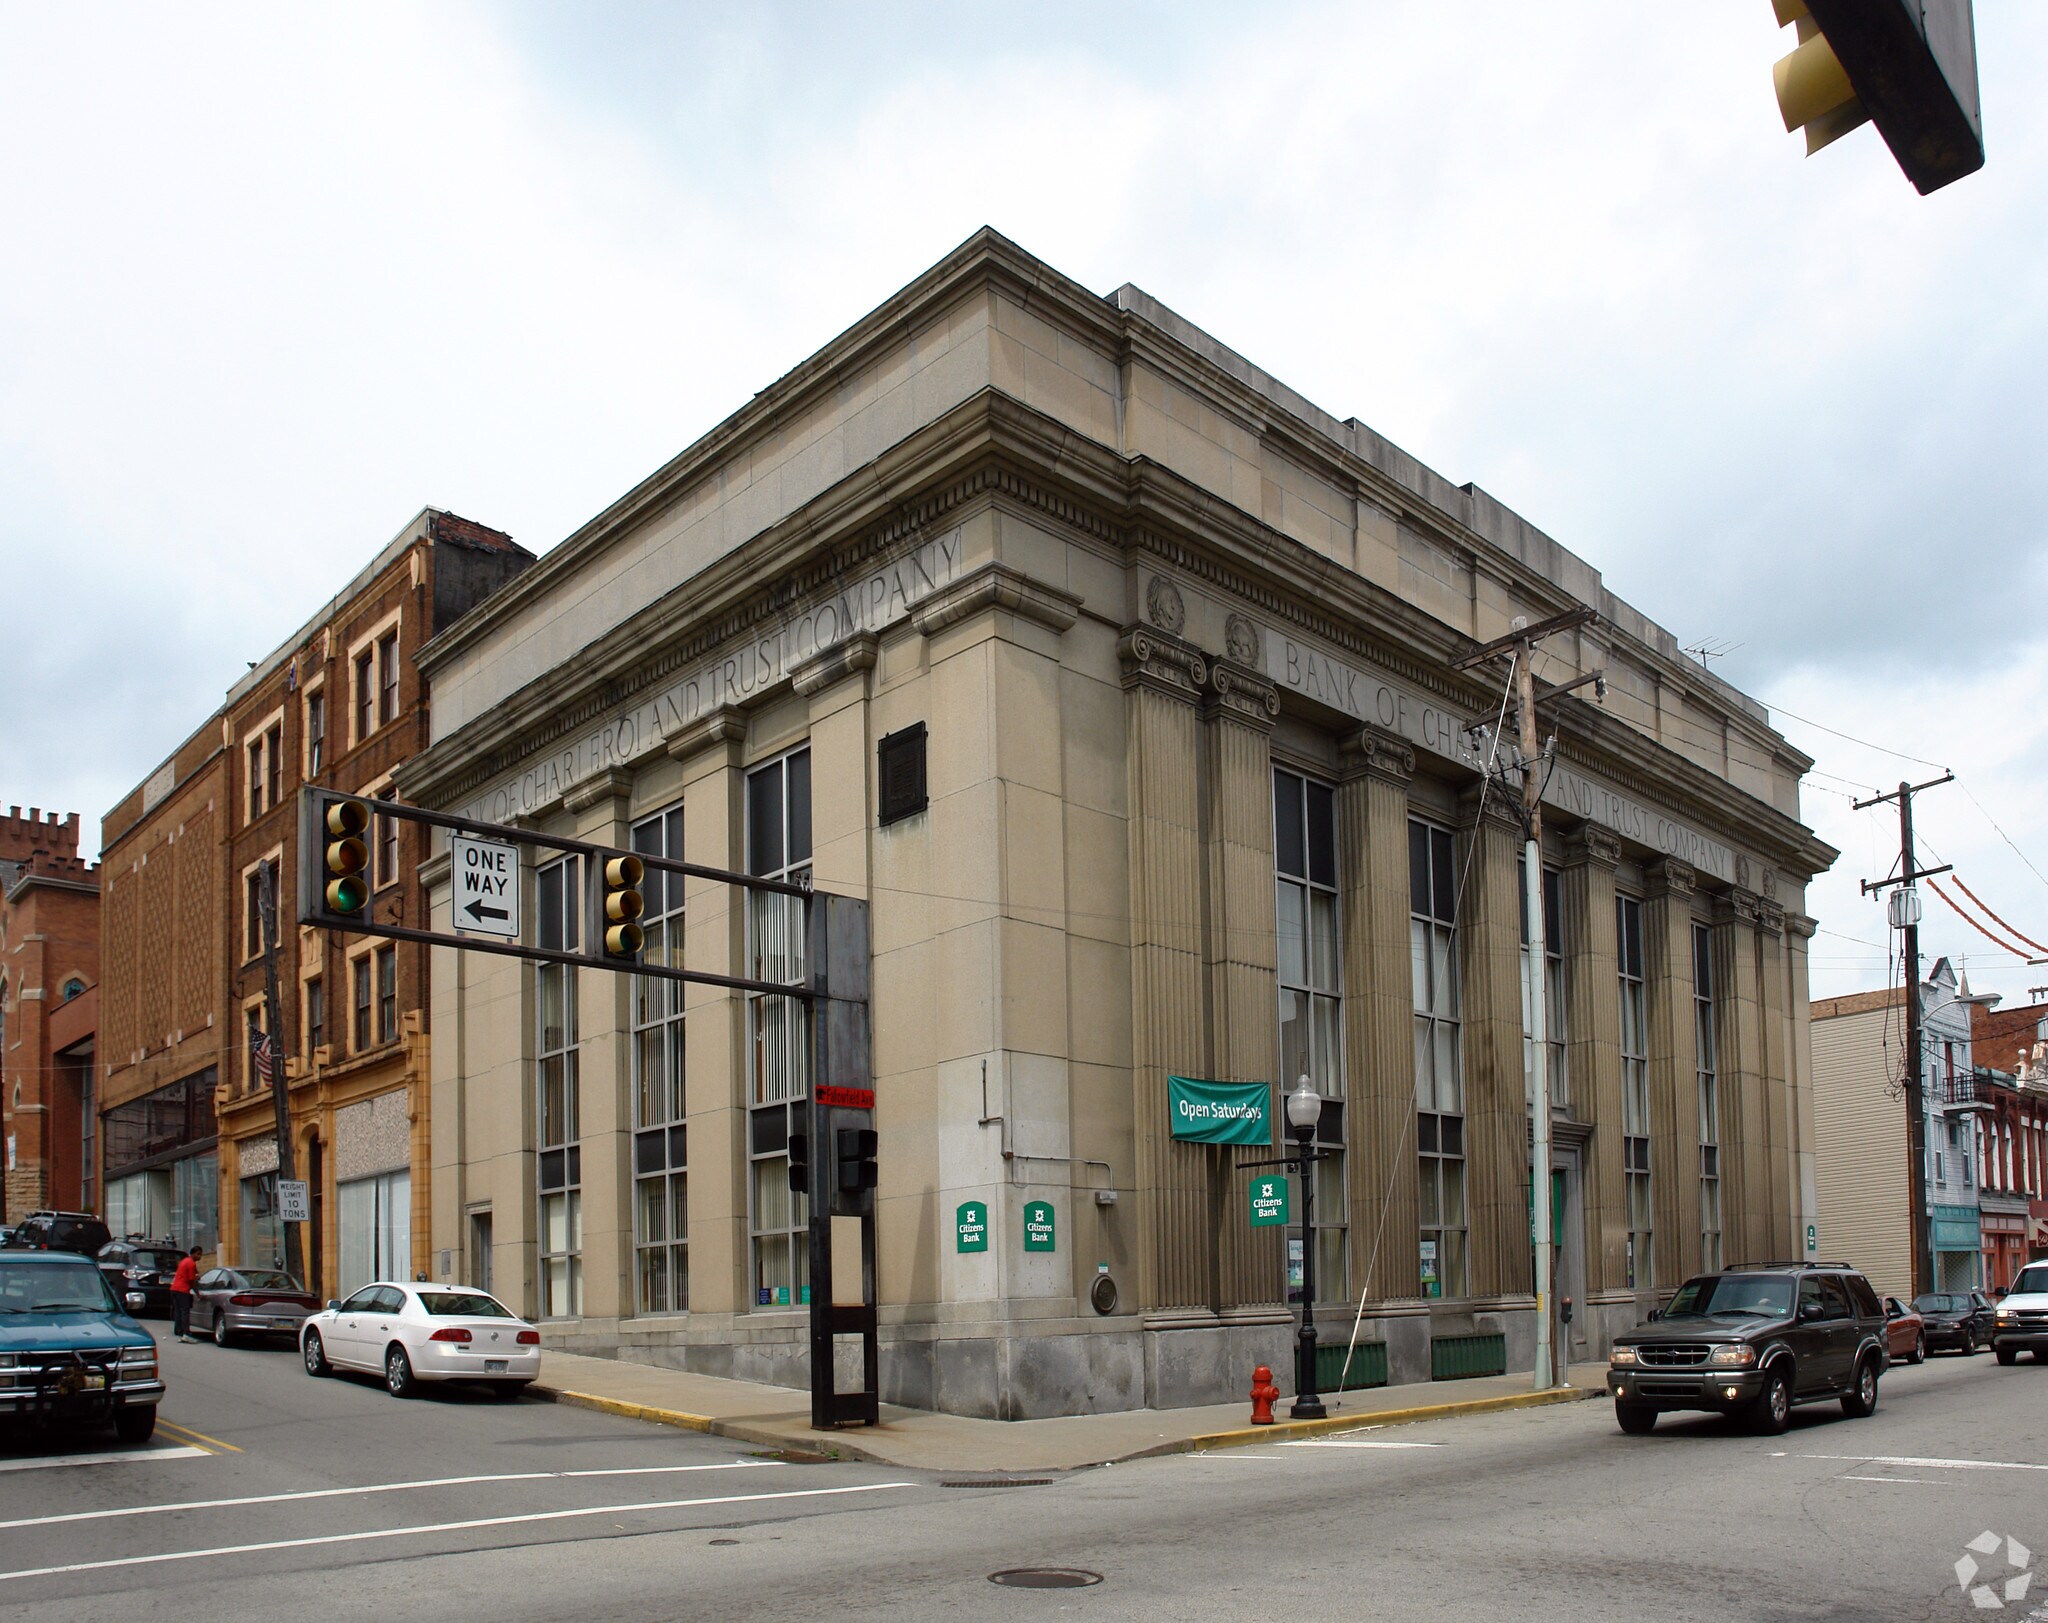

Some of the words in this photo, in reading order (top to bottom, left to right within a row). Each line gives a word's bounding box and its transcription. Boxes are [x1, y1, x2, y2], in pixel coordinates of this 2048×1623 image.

[493, 781, 517, 823] OF
[651, 680, 700, 739] AND
[708, 629, 788, 710] TRUST
[797, 532, 959, 661] COMPANY
[1285, 641, 1361, 715] BANK
[1376, 686, 1407, 735] OF
[1557, 771, 1593, 816] AND
[1601, 791, 1649, 842] TRUST
[1657, 818, 1726, 878] COMPANY
[466, 847, 506, 873] ONE
[465, 871, 508, 896] WAY
[1179, 1099, 1209, 1121] Open
[1211, 1102, 1262, 1123] Saturdays
[280, 1183, 305, 1191] WEIGHT
[284, 1191, 301, 1199] LIMIT
[288, 1200, 299, 1208] 10
[1253, 1198, 1283, 1208] Citizens
[283, 1209, 305, 1218] TONS
[1258, 1206, 1278, 1218] Bank
[959, 1224, 984, 1233] Citizens
[1027, 1223, 1052, 1232] Citizens
[963, 1233, 980, 1243] Bank
[1031, 1232, 1048, 1242] Bank
